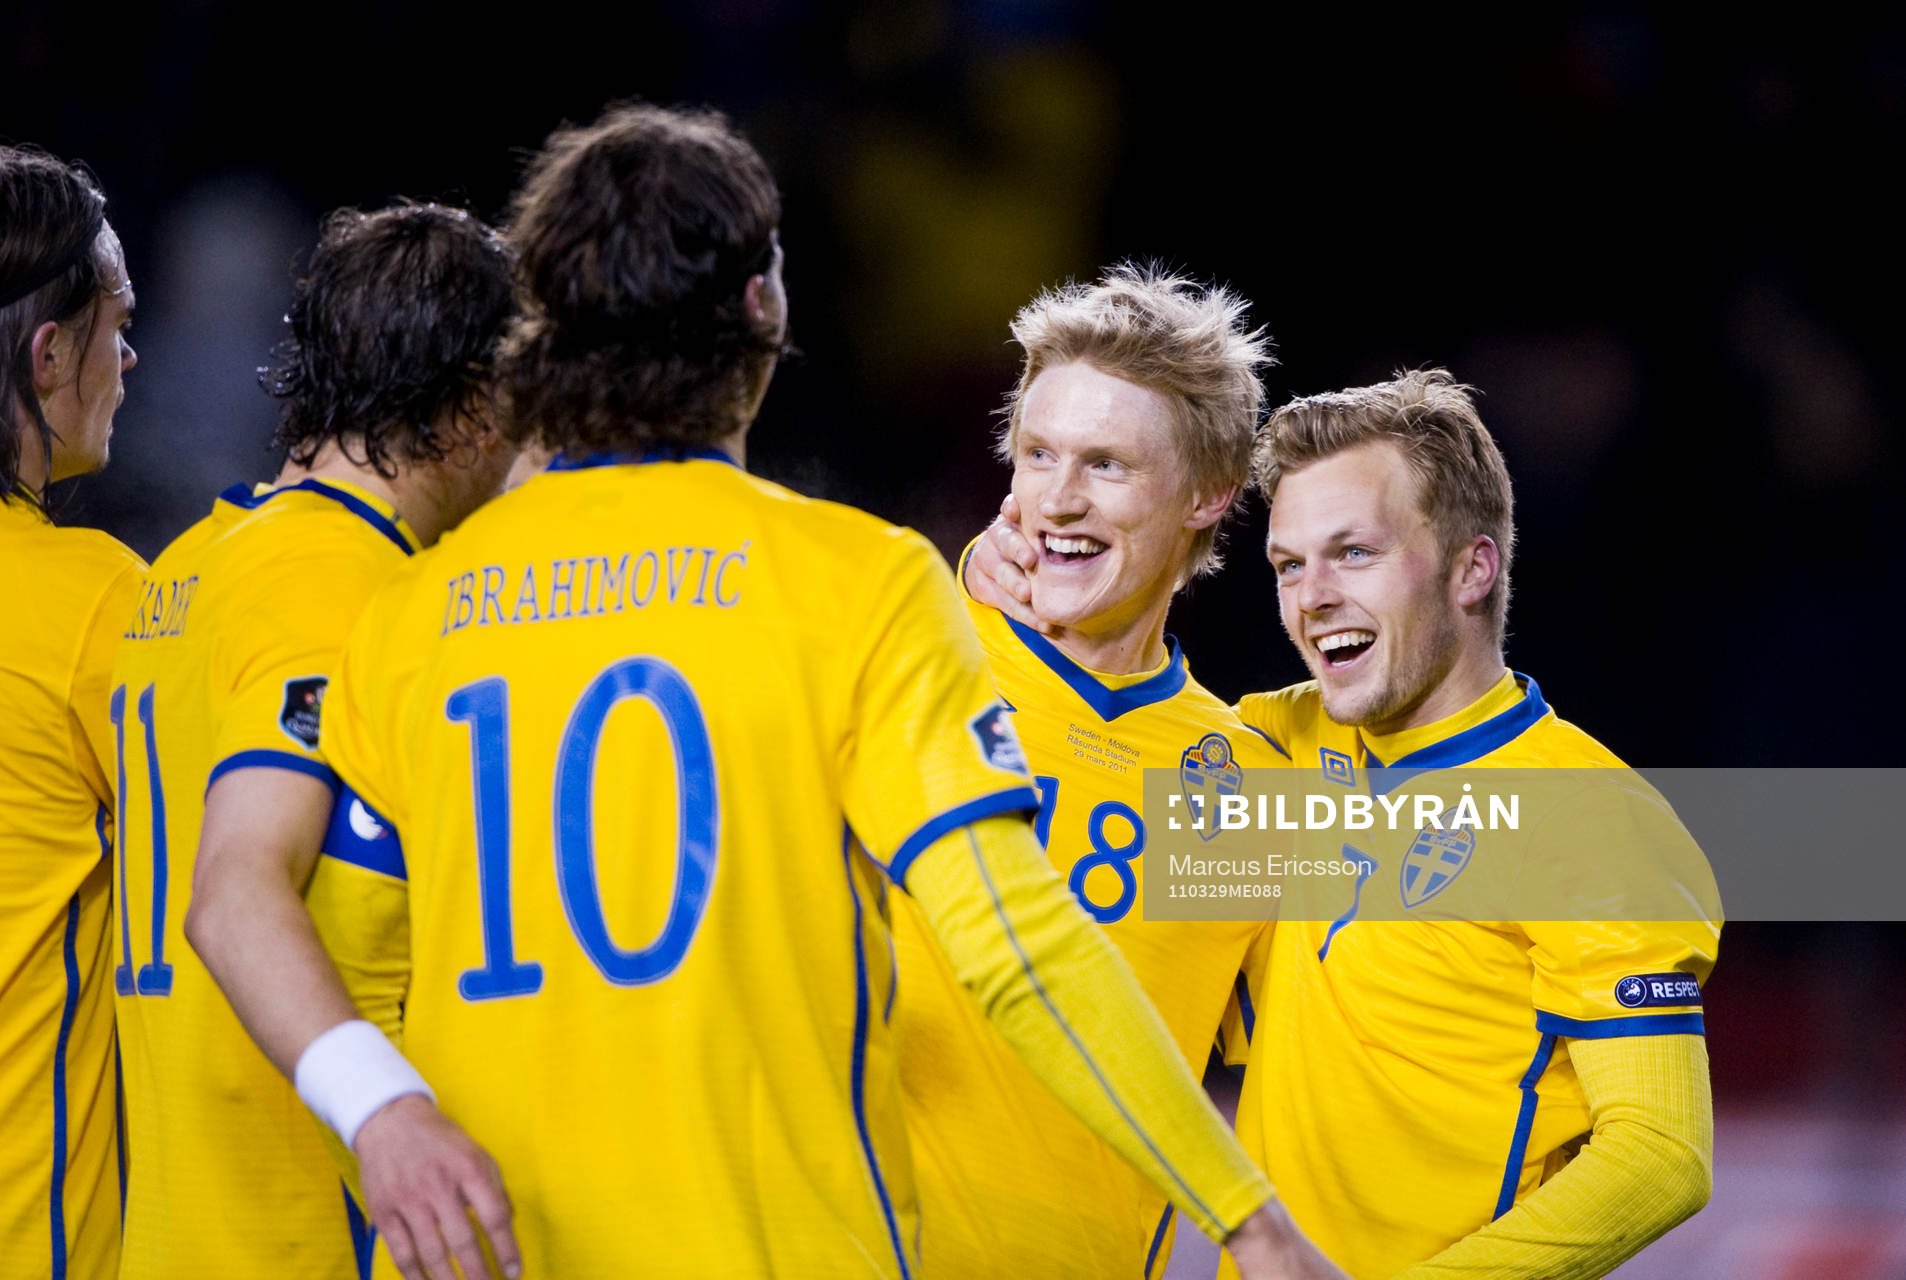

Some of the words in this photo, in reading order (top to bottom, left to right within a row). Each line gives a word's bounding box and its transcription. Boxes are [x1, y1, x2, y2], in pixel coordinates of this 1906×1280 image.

[441, 540, 752, 637] IBRAHIMOVIĆ
[1068, 723, 1102, 742] Sweden
[1108, 738, 1141, 758] Moldova
[1086, 754, 1107, 767] mars
[1108, 760, 1128, 774] 2011
[1105, 748, 1137, 767] Stadium
[110, 682, 173, 996] 11
[446, 655, 720, 1002] 10
[1034, 775, 1147, 924] 18
[1317, 842, 1379, 963] 7
